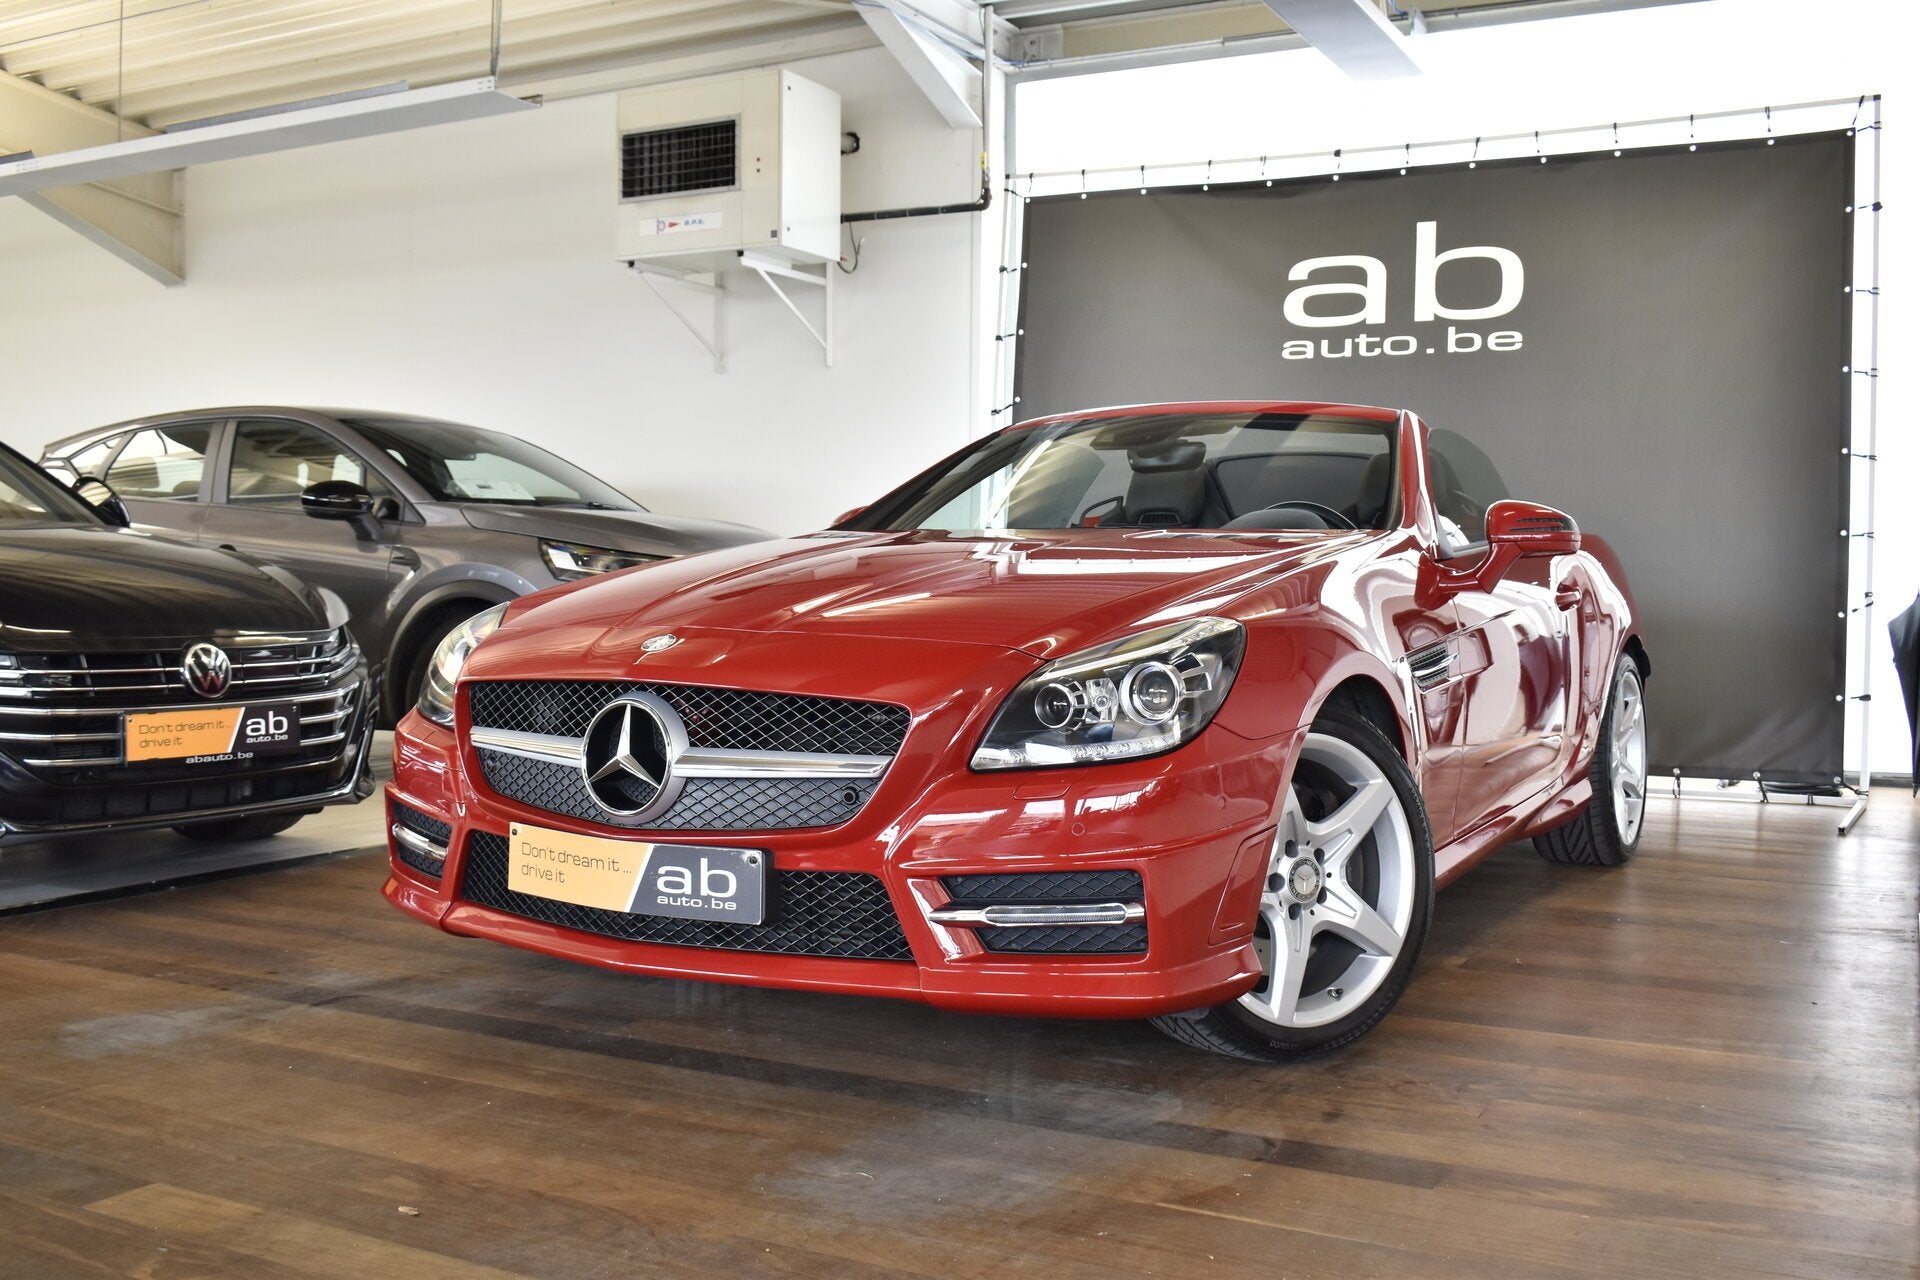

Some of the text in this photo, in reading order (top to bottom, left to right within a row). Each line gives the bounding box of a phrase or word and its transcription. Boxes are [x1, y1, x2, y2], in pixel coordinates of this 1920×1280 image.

[1283, 221, 1525, 328] ab
[1281, 326, 1523, 360] auto.be
[138, 722, 174, 735] Don't
[175, 720, 215, 732] dream
[245, 710, 289, 737] ab
[138, 736, 183, 749] drive it
[245, 734, 289, 744] auto.be
[185, 751, 254, 764] abauto.be
[521, 841, 556, 861] Don't
[557, 851, 605, 871] dream
[521, 863, 566, 883] drive it
[656, 857, 737, 898] ab
[656, 895, 737, 911] auto.be
